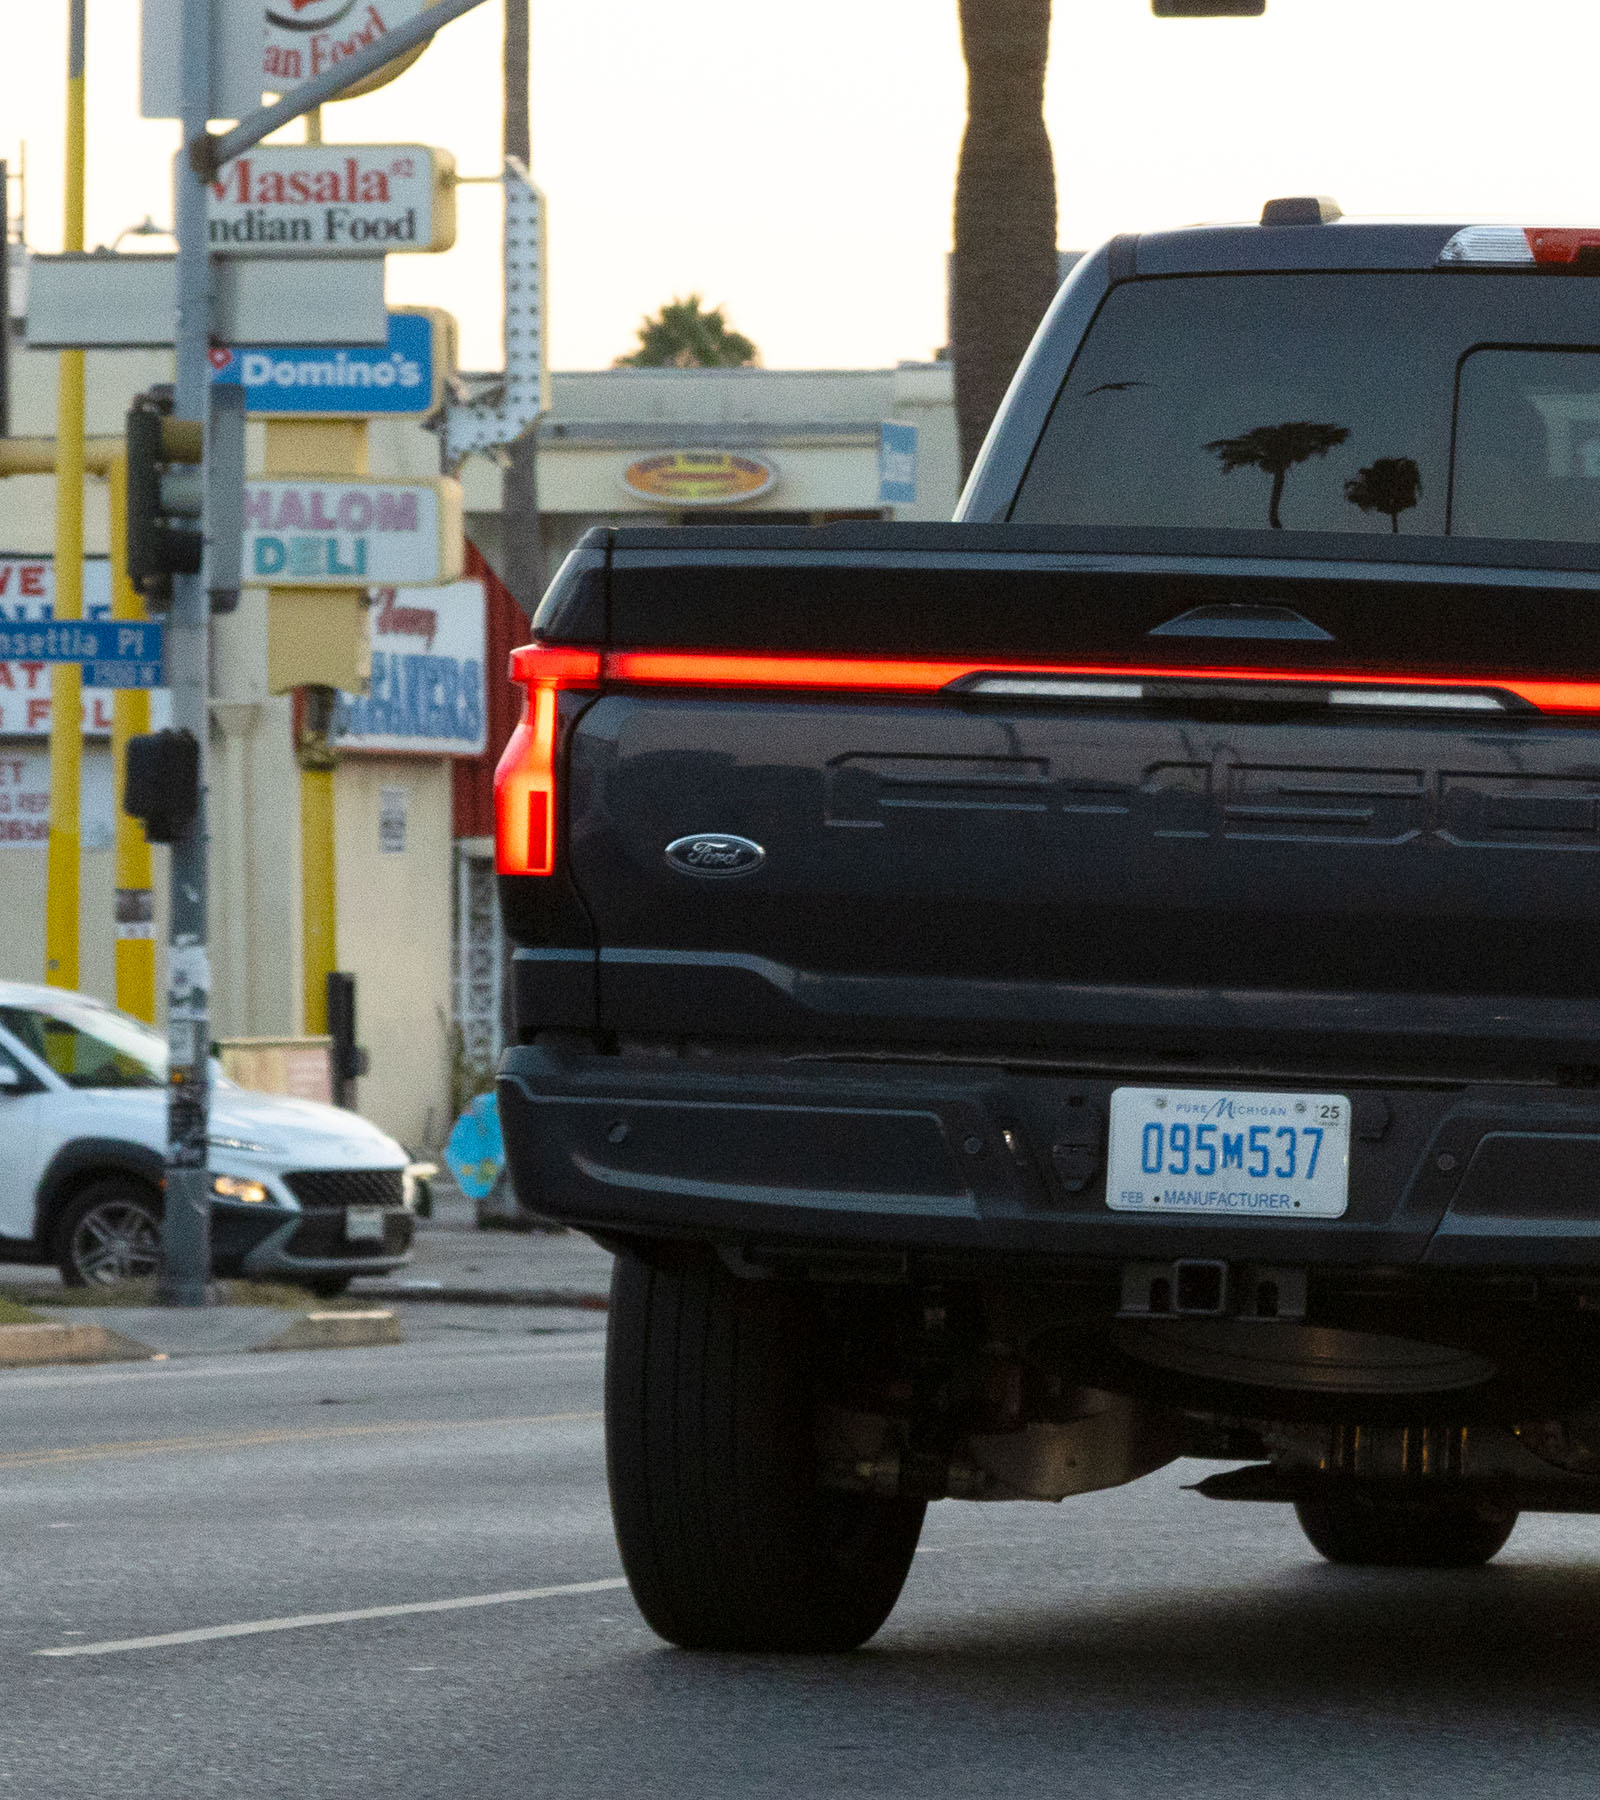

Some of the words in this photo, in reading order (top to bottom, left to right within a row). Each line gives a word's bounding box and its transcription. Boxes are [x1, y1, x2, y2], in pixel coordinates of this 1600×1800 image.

[208, 209, 312, 242] ndian
[325, 209, 415, 242] Food
[242, 352, 421, 387] Domino's
[244, 490, 418, 532] HALOM
[253, 536, 367, 576] DELI
[117, 628, 147, 657] Pl
[688, 841, 742, 865] Ford
[1176, 1104, 1207, 1115] PURE
[1202, 1097, 1287, 1121] MICHIGAN
[1142, 1121, 1325, 1180] 095M537
[1121, 1191, 1144, 1204] FEB
[1164, 1190, 1290, 1208] MANUFACTURER
